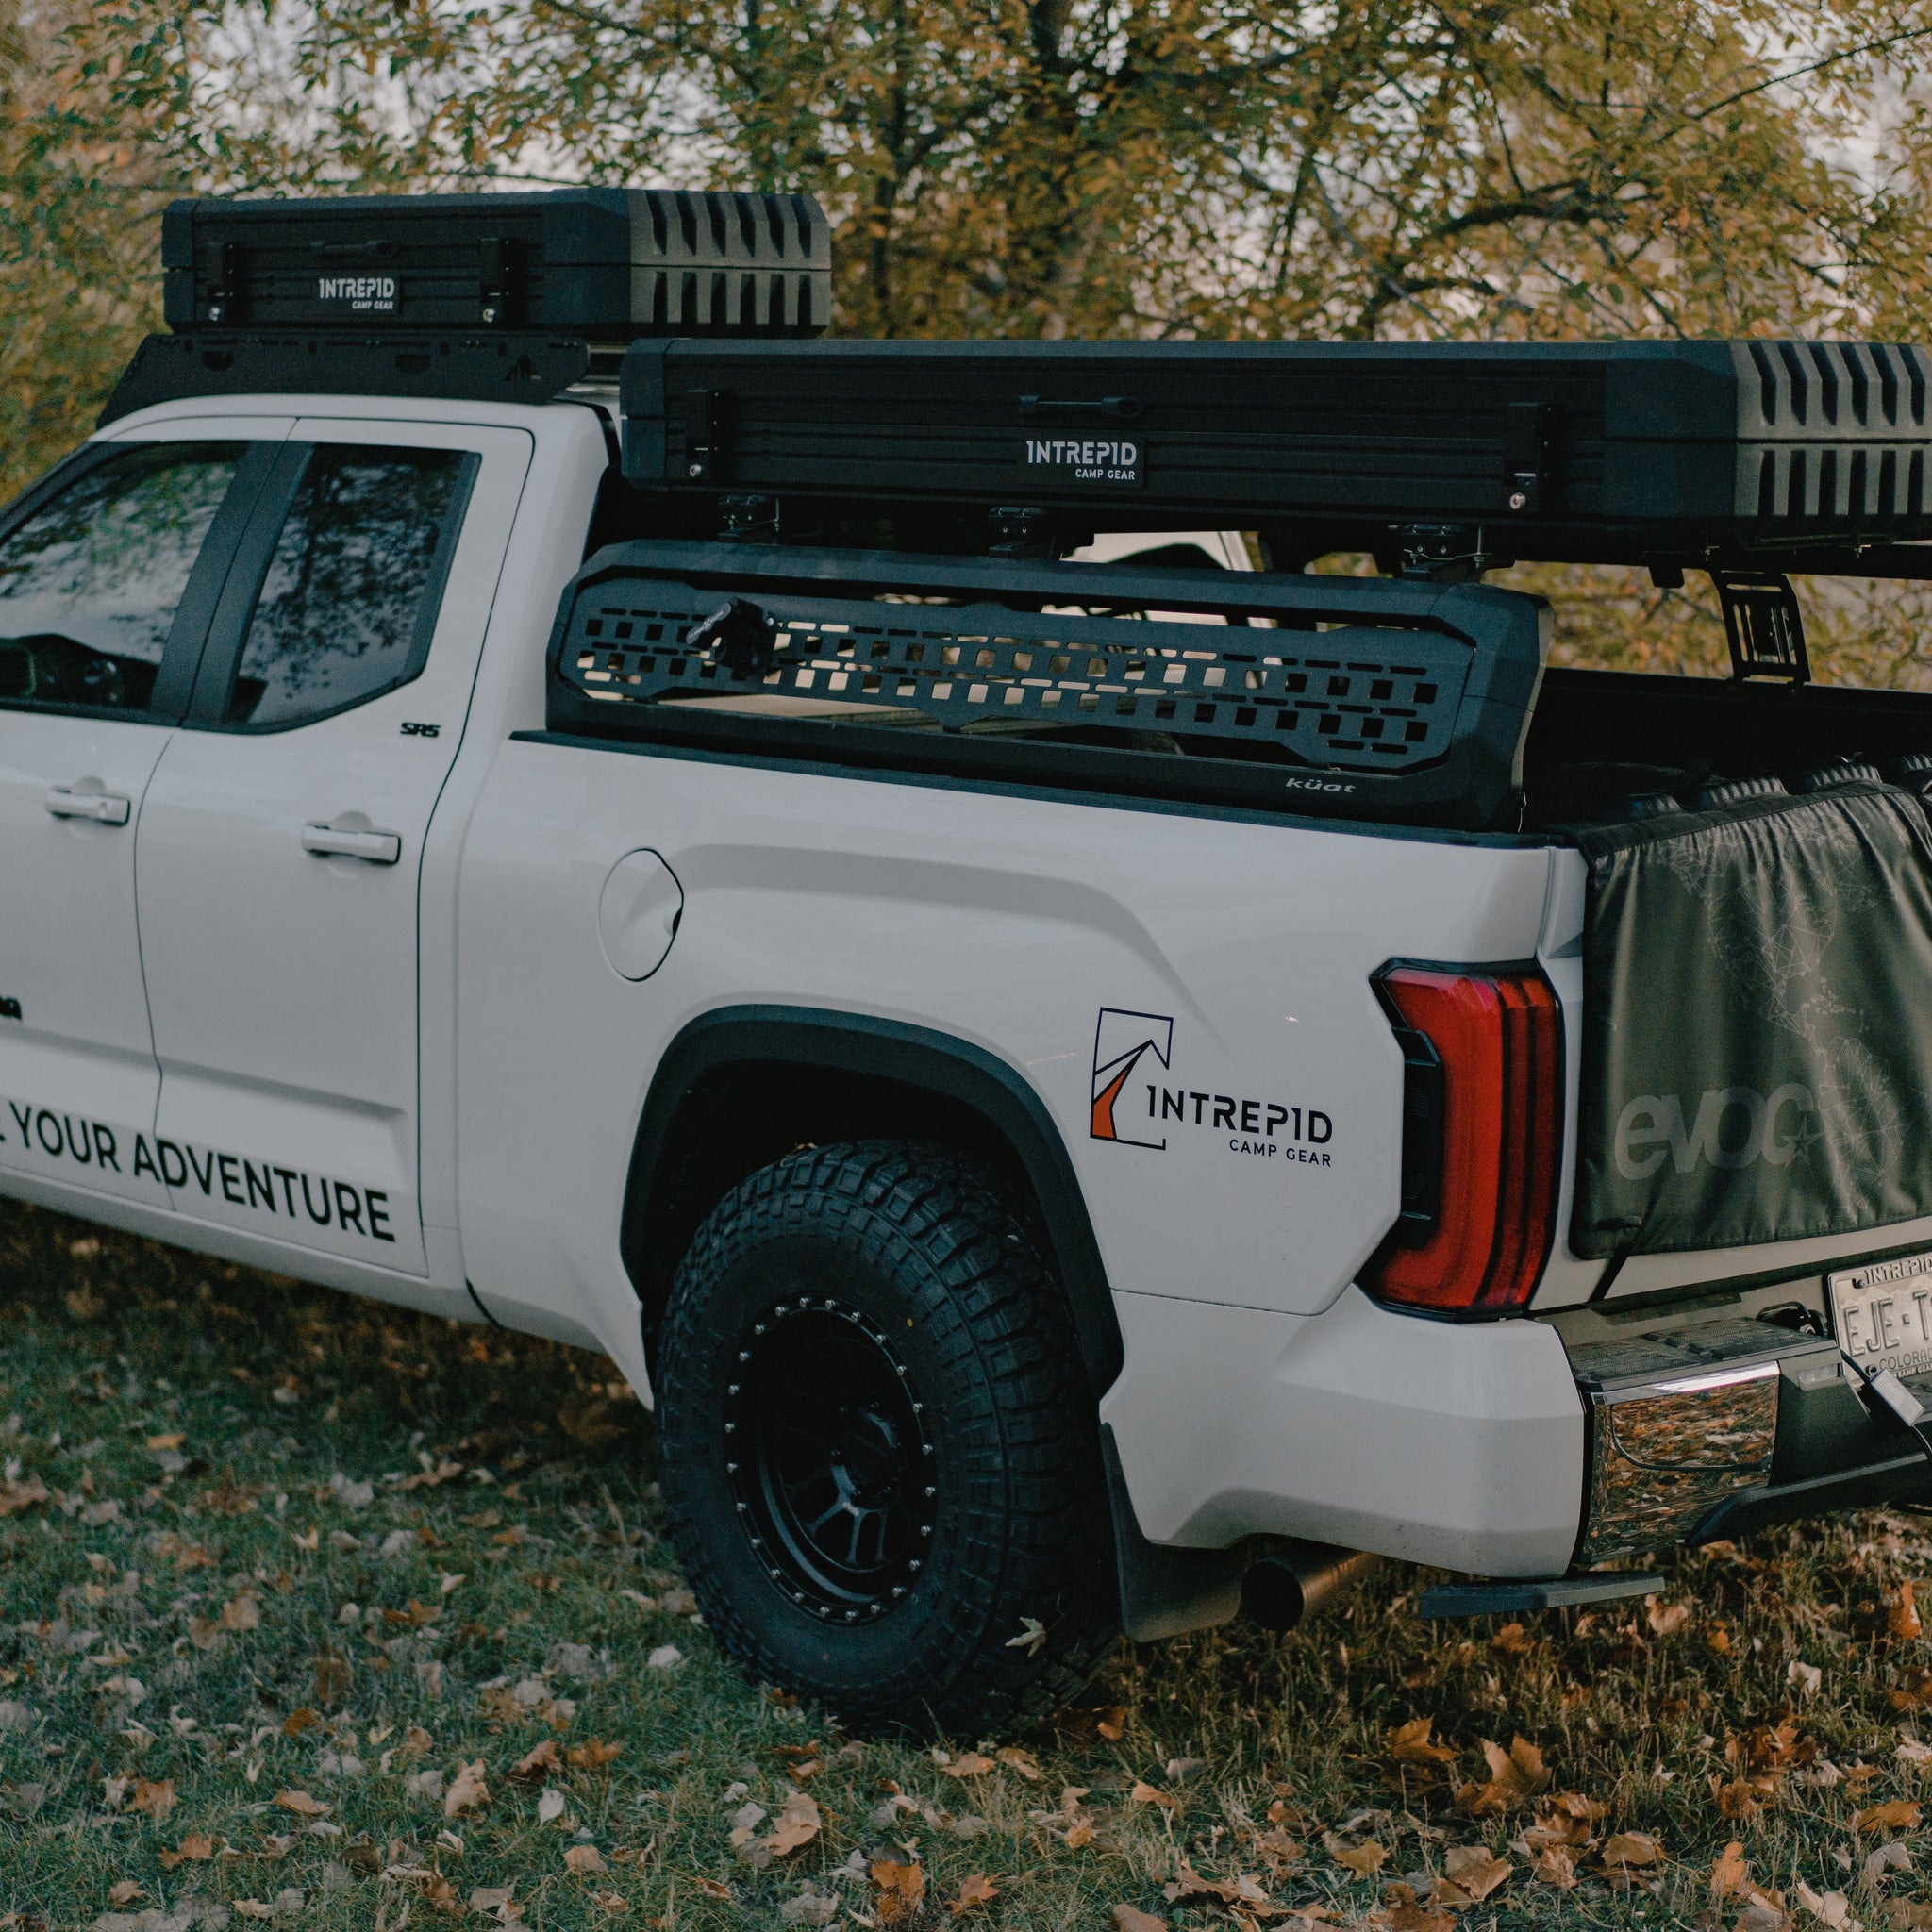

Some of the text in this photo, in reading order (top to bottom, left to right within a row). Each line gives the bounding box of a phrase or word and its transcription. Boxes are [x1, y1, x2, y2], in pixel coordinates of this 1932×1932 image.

[319, 277, 395, 299] INTREPID
[352, 300, 393, 310] CAMP GEAR
[1026, 441, 1137, 466] INTREPID
[1075, 468, 1135, 480] CAMP GEAR
[1285, 777, 1356, 793] küat
[1146, 1085, 1333, 1144] INTREPID
[1229, 1139, 1331, 1167] CAMP GEAR
[9, 1100, 396, 1242] YOUR ADVENTURE
[1879, 1348, 1932, 1370] COLORAD
[1917, 1364, 1932, 1374] GEA
